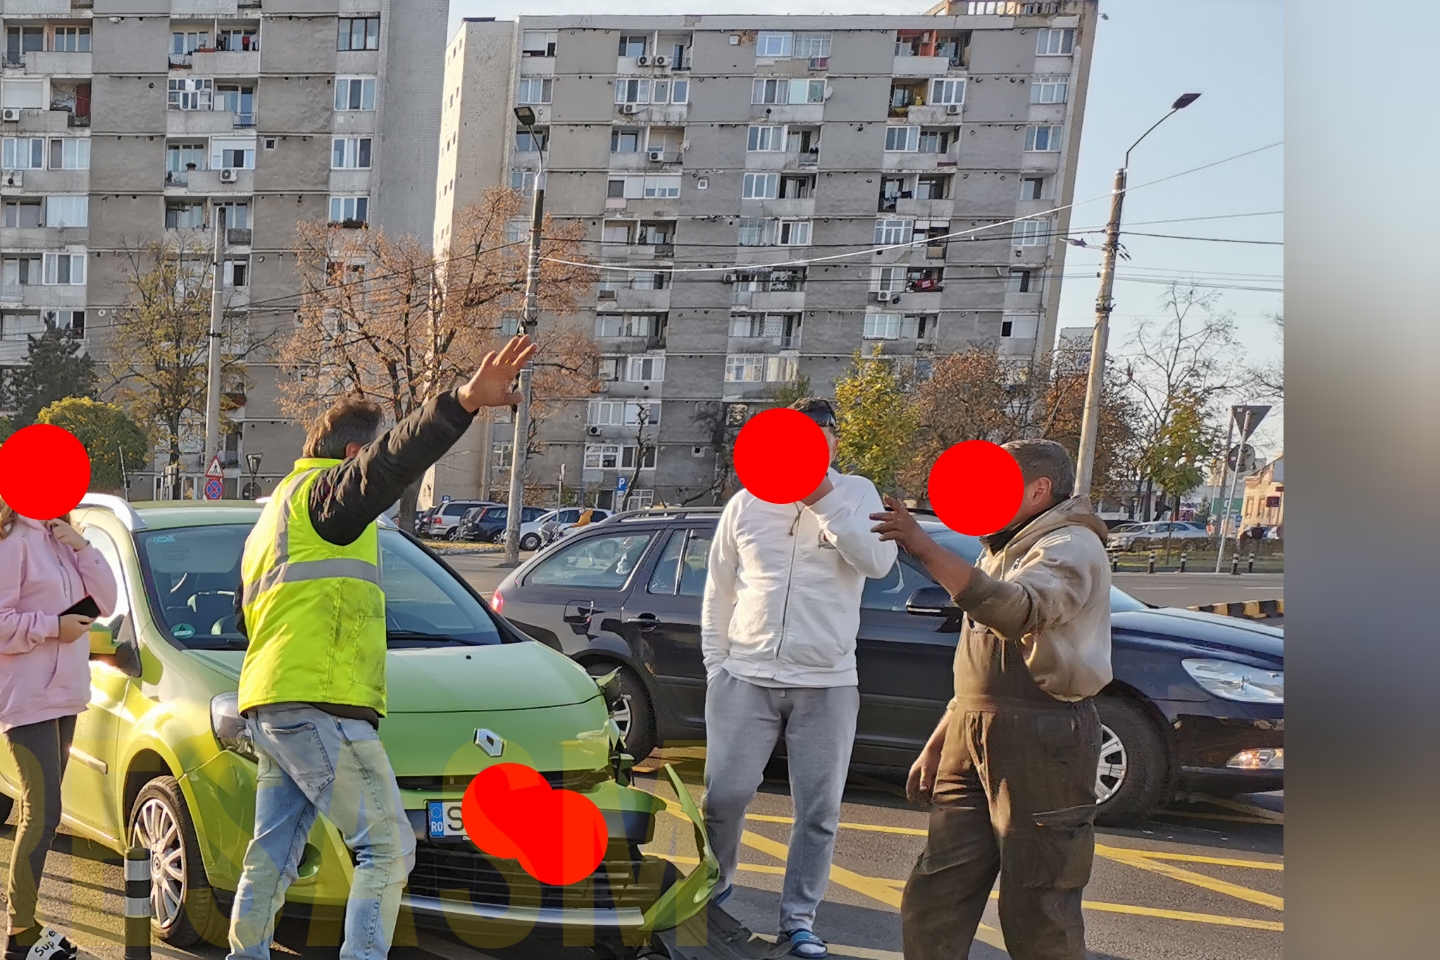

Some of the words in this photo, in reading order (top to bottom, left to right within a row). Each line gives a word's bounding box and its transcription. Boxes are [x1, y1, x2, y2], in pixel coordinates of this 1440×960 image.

[618, 477, 625, 488] P
[447, 806, 464, 832] S
[431, 821, 443, 832] RO
